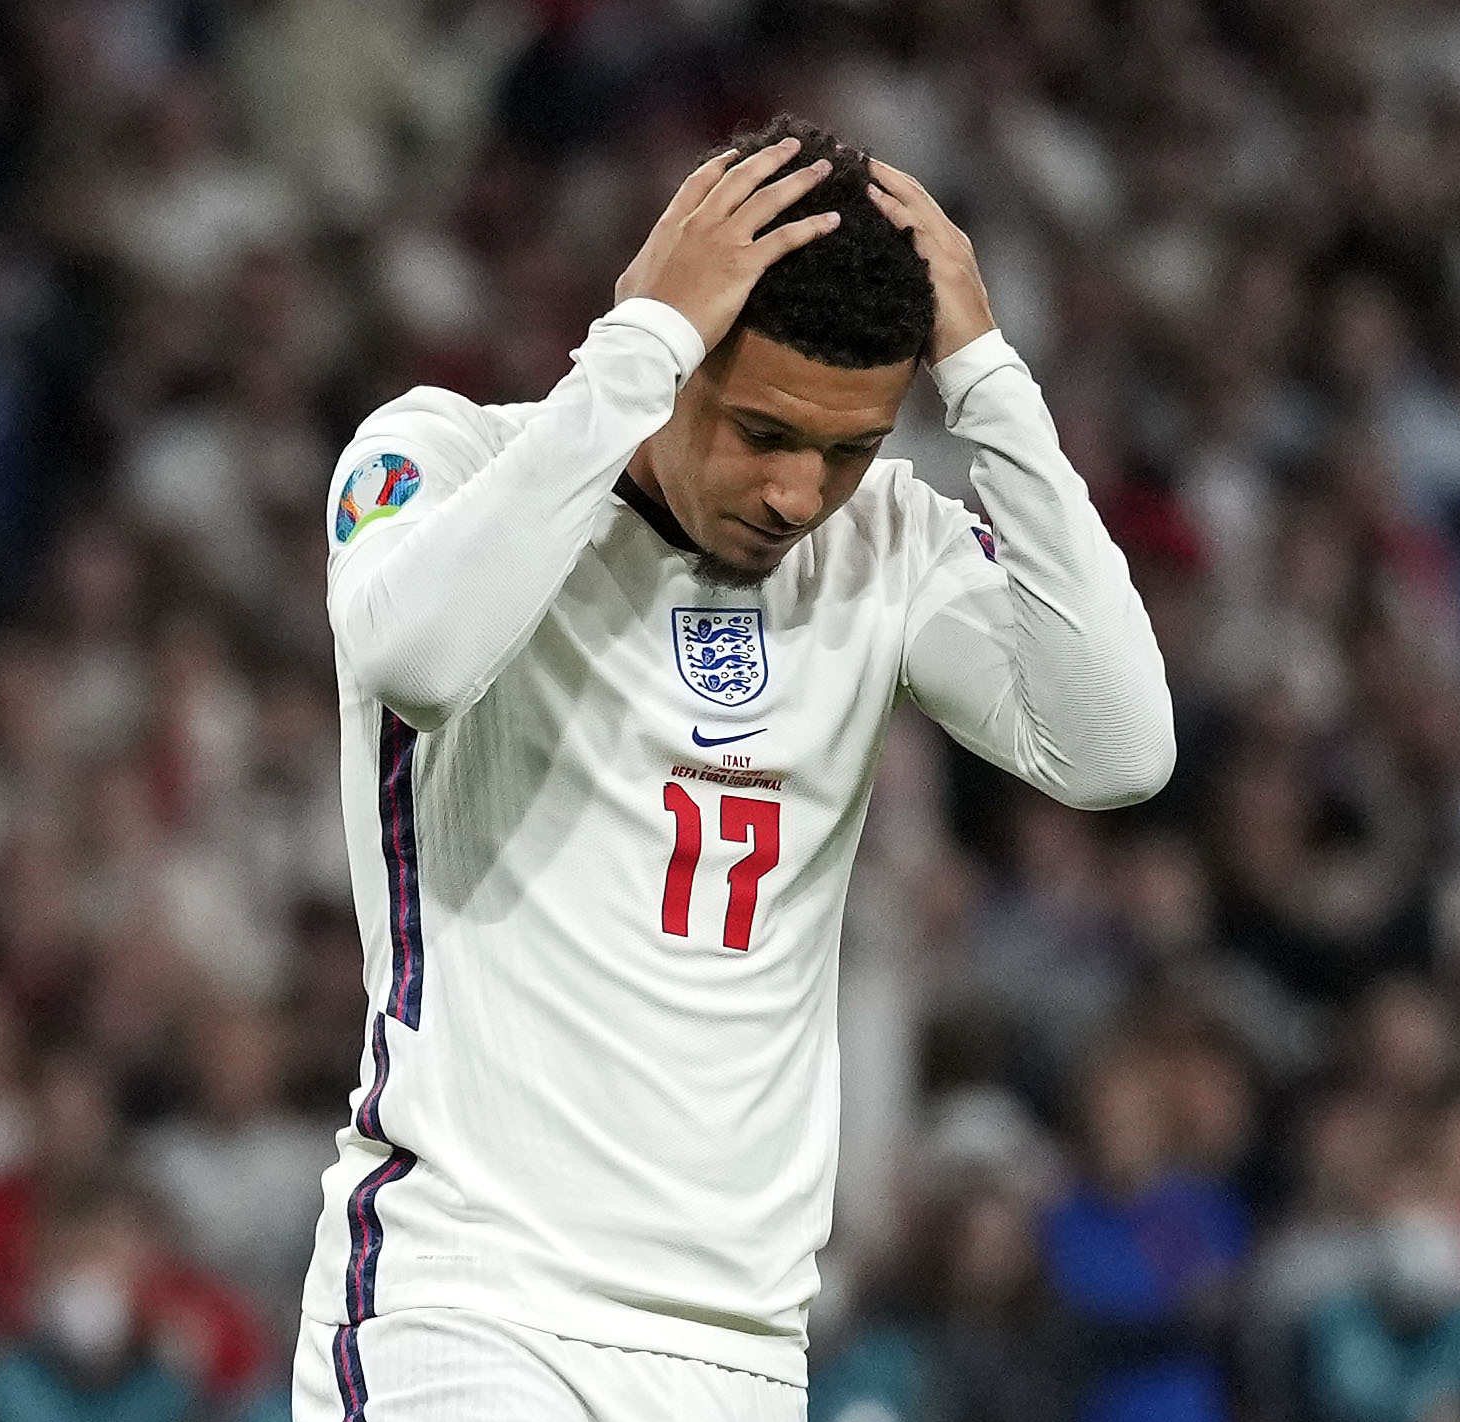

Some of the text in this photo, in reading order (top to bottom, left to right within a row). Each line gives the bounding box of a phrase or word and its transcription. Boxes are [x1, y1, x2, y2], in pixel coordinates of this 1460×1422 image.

[722, 754, 751, 768] ITALY
[671, 765, 697, 779] UEFA
[699, 771, 727, 784] EURO
[753, 778, 782, 791] FINAL
[662, 781, 781, 951] 17
